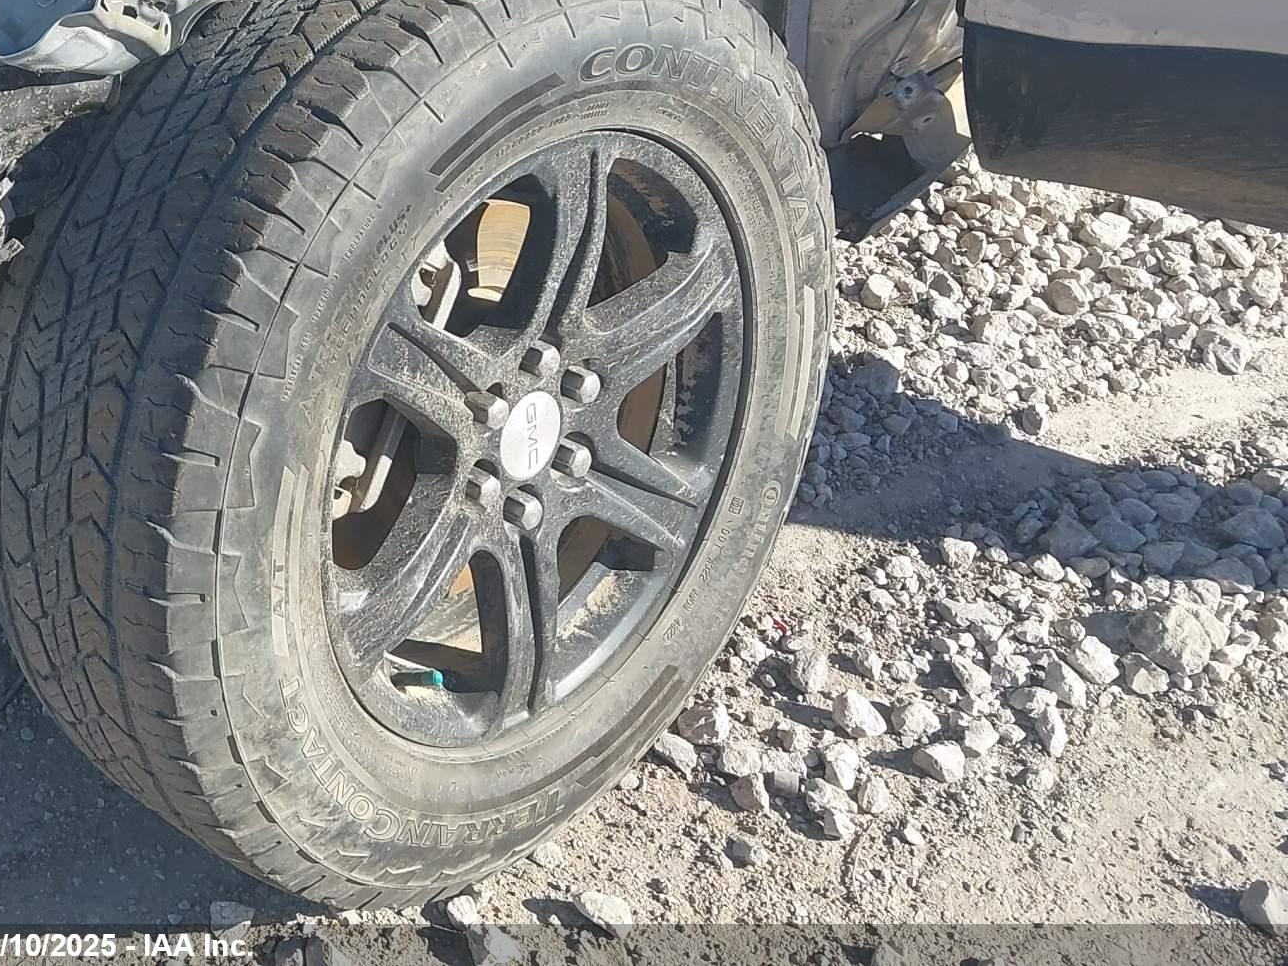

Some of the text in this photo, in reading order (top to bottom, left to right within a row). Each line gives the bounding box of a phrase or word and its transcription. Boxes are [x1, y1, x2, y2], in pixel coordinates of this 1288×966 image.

[579, 42, 816, 273] CONTINENTAL
[526, 402, 538, 472] GMC
[714, 527, 731, 555] DOT
[271, 558, 286, 619] A/T
